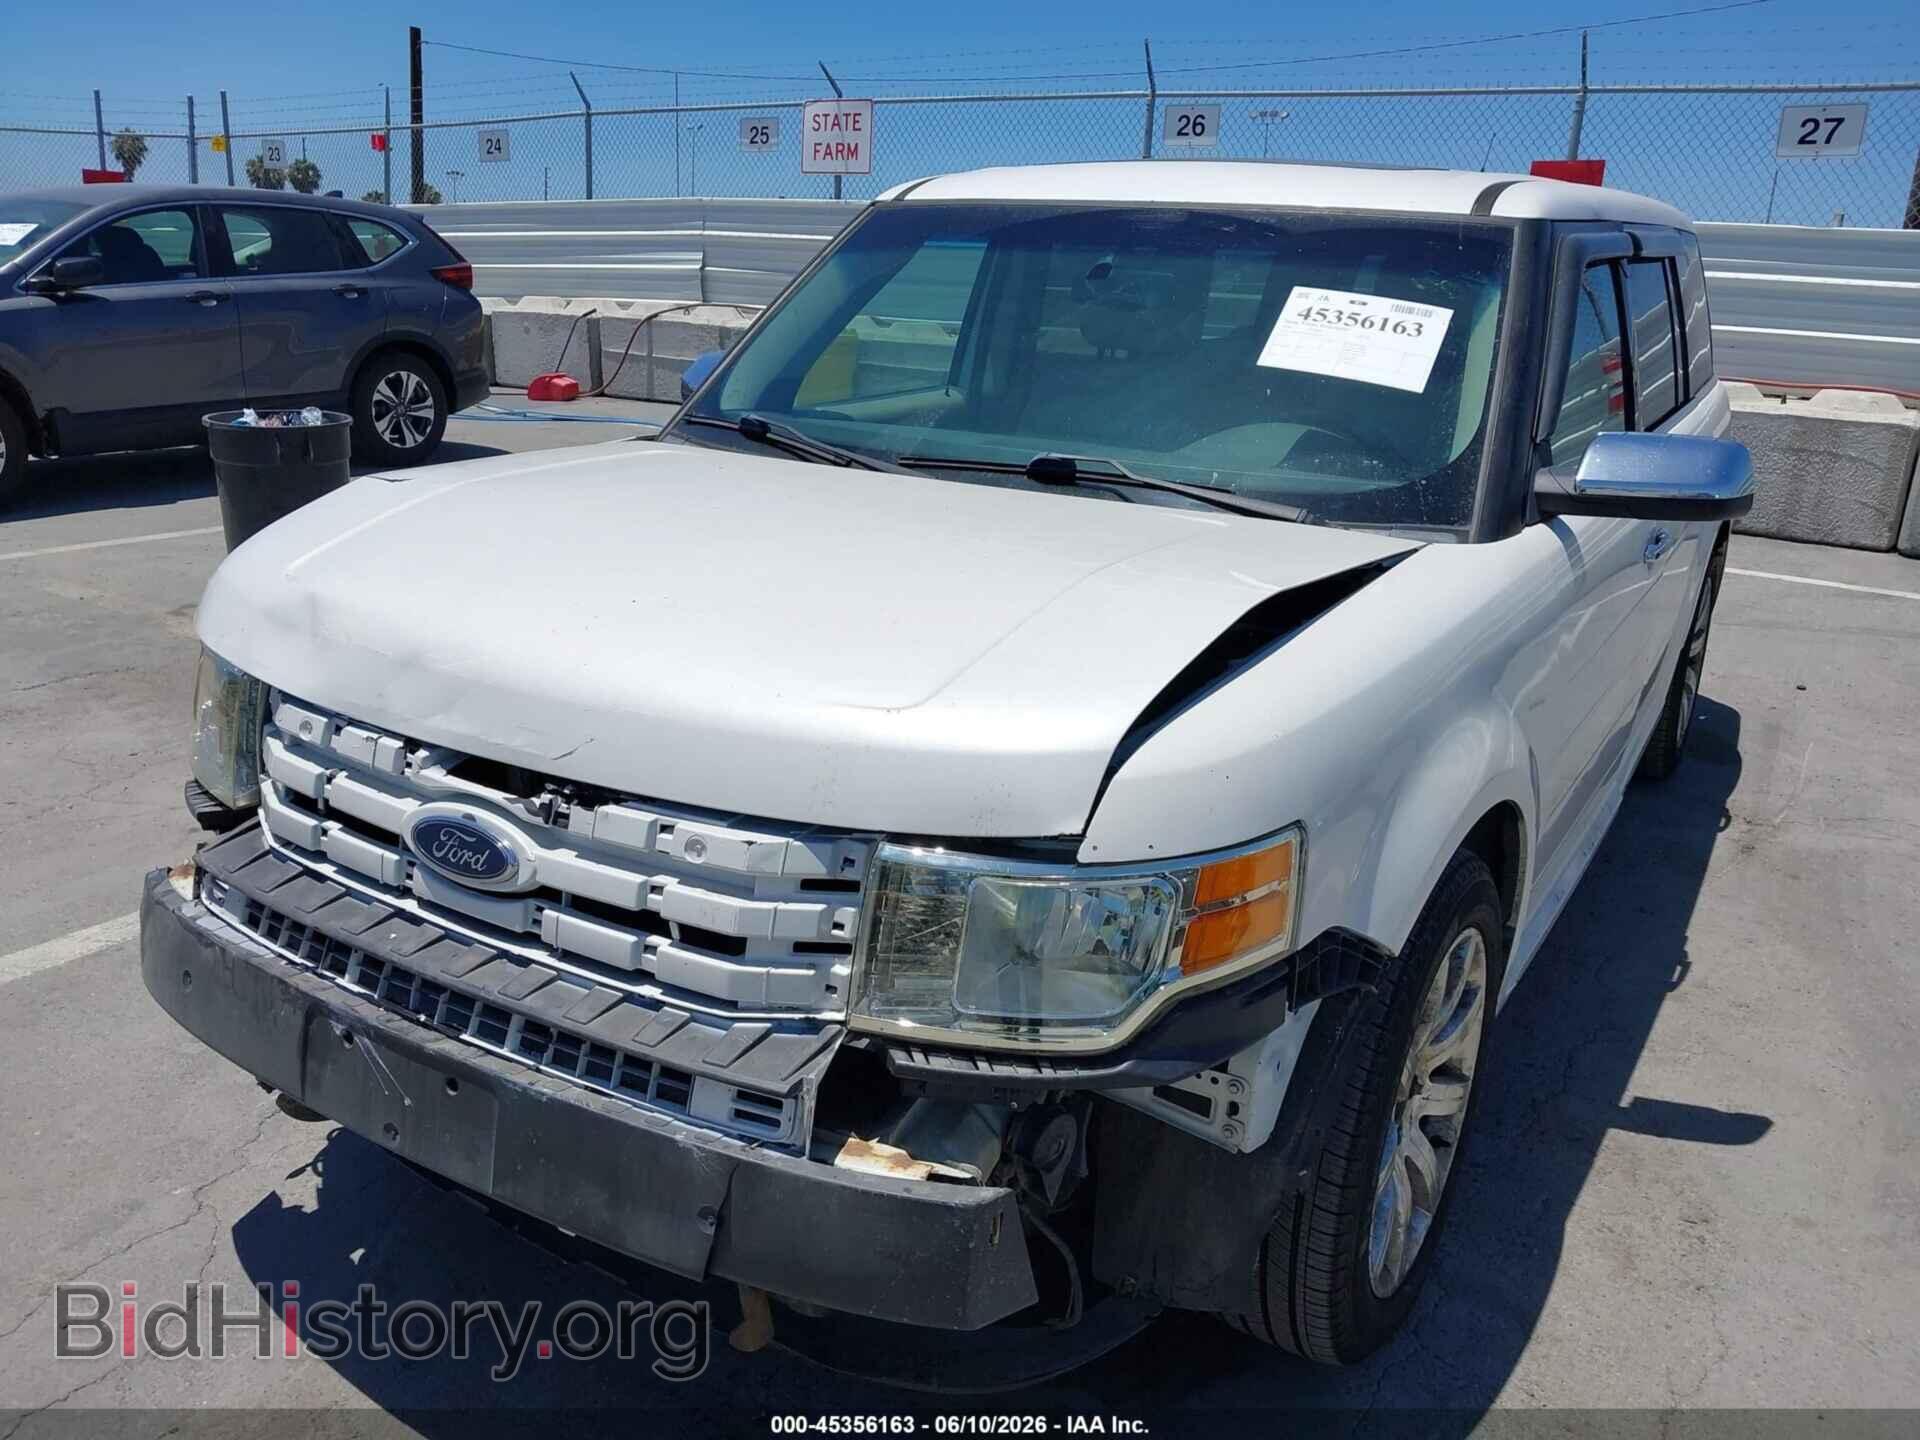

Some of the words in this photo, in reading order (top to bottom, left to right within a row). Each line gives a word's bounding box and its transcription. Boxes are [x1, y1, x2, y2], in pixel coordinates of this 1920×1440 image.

[812, 113, 862, 131] STATE
[1177, 114, 1206, 137] 26
[1797, 117, 1846, 145] 27
[749, 126, 769, 144] 25
[267, 146, 281, 162] 23
[486, 138, 502, 154] 24
[813, 143, 859, 161] FARM
[1297, 305, 1424, 338] 45356163
[432, 827, 490, 872] Ford
